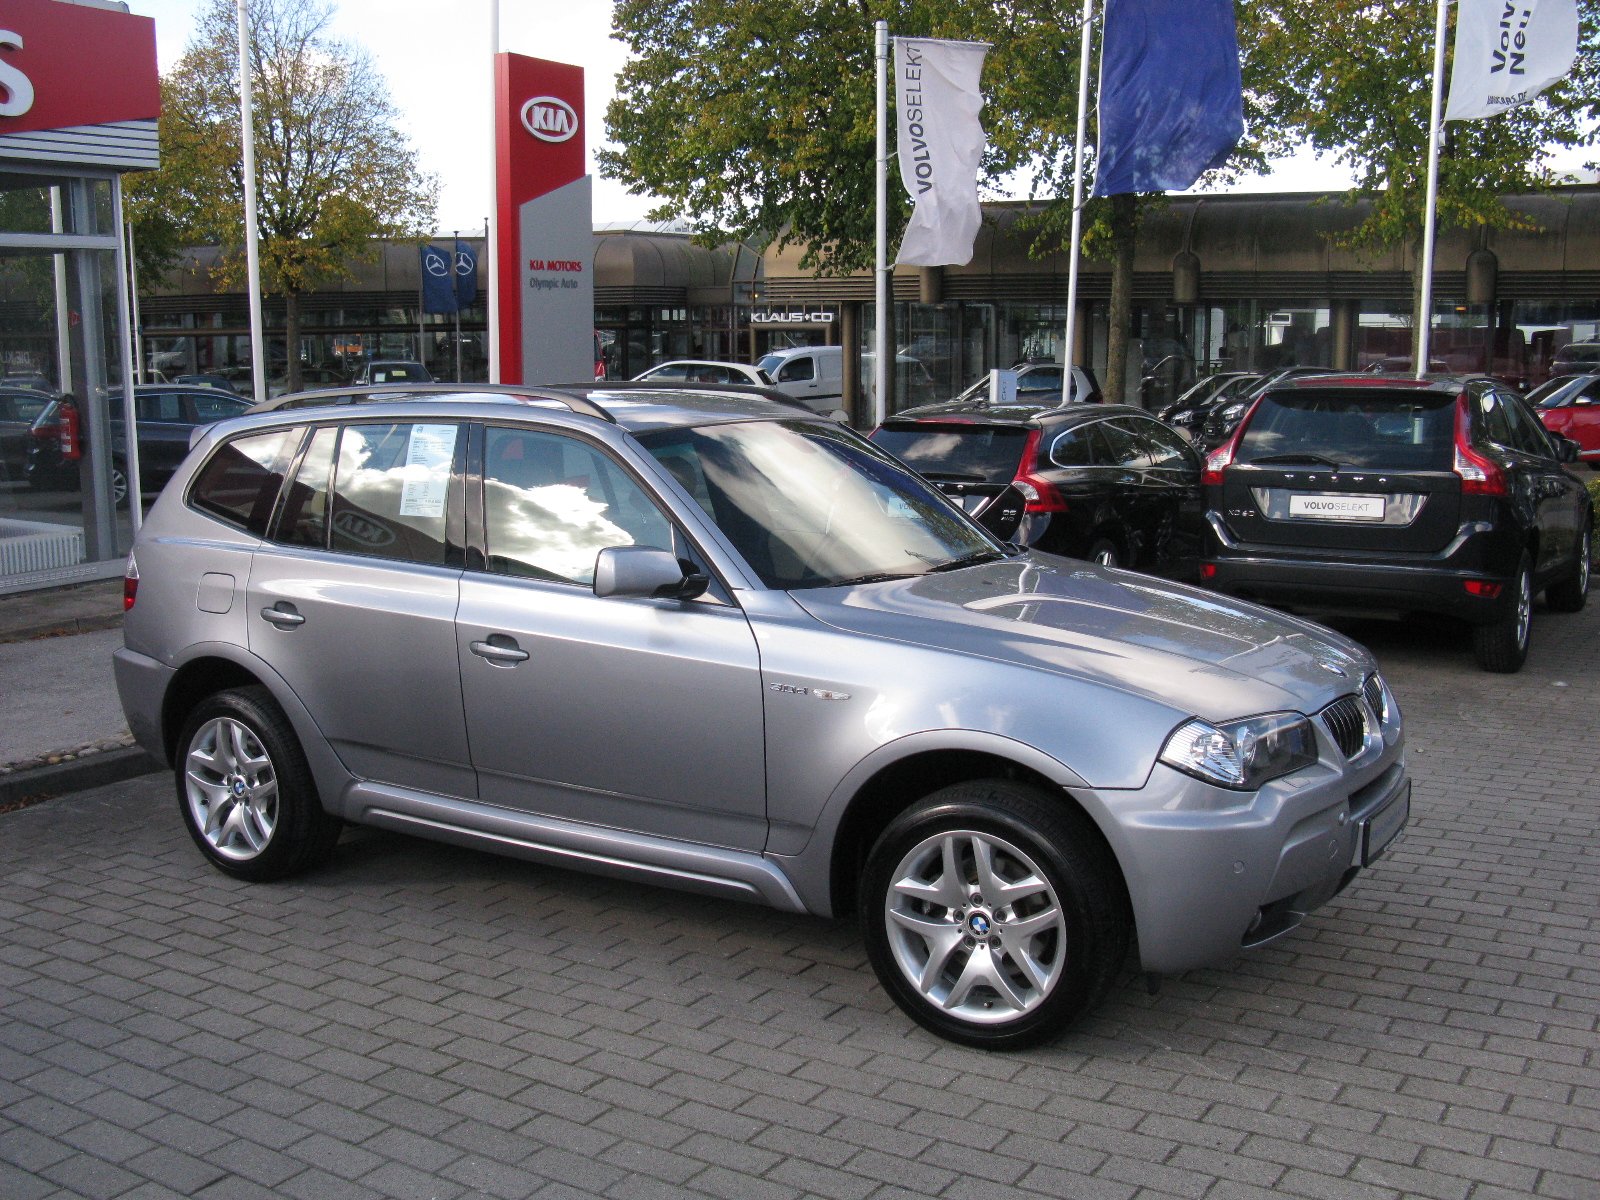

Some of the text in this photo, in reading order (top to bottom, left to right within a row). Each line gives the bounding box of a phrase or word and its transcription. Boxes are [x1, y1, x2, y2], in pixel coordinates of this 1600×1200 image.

[1490, 0, 1515, 74] Volv
[531, 105, 570, 132] KIA
[905, 42, 933, 195] VOLVOSELEKT
[530, 260, 582, 272] KIA MOTORS
[530, 277, 578, 290] Olympic Auto
[1303, 501, 1370, 512] VOLVOSELEKT
